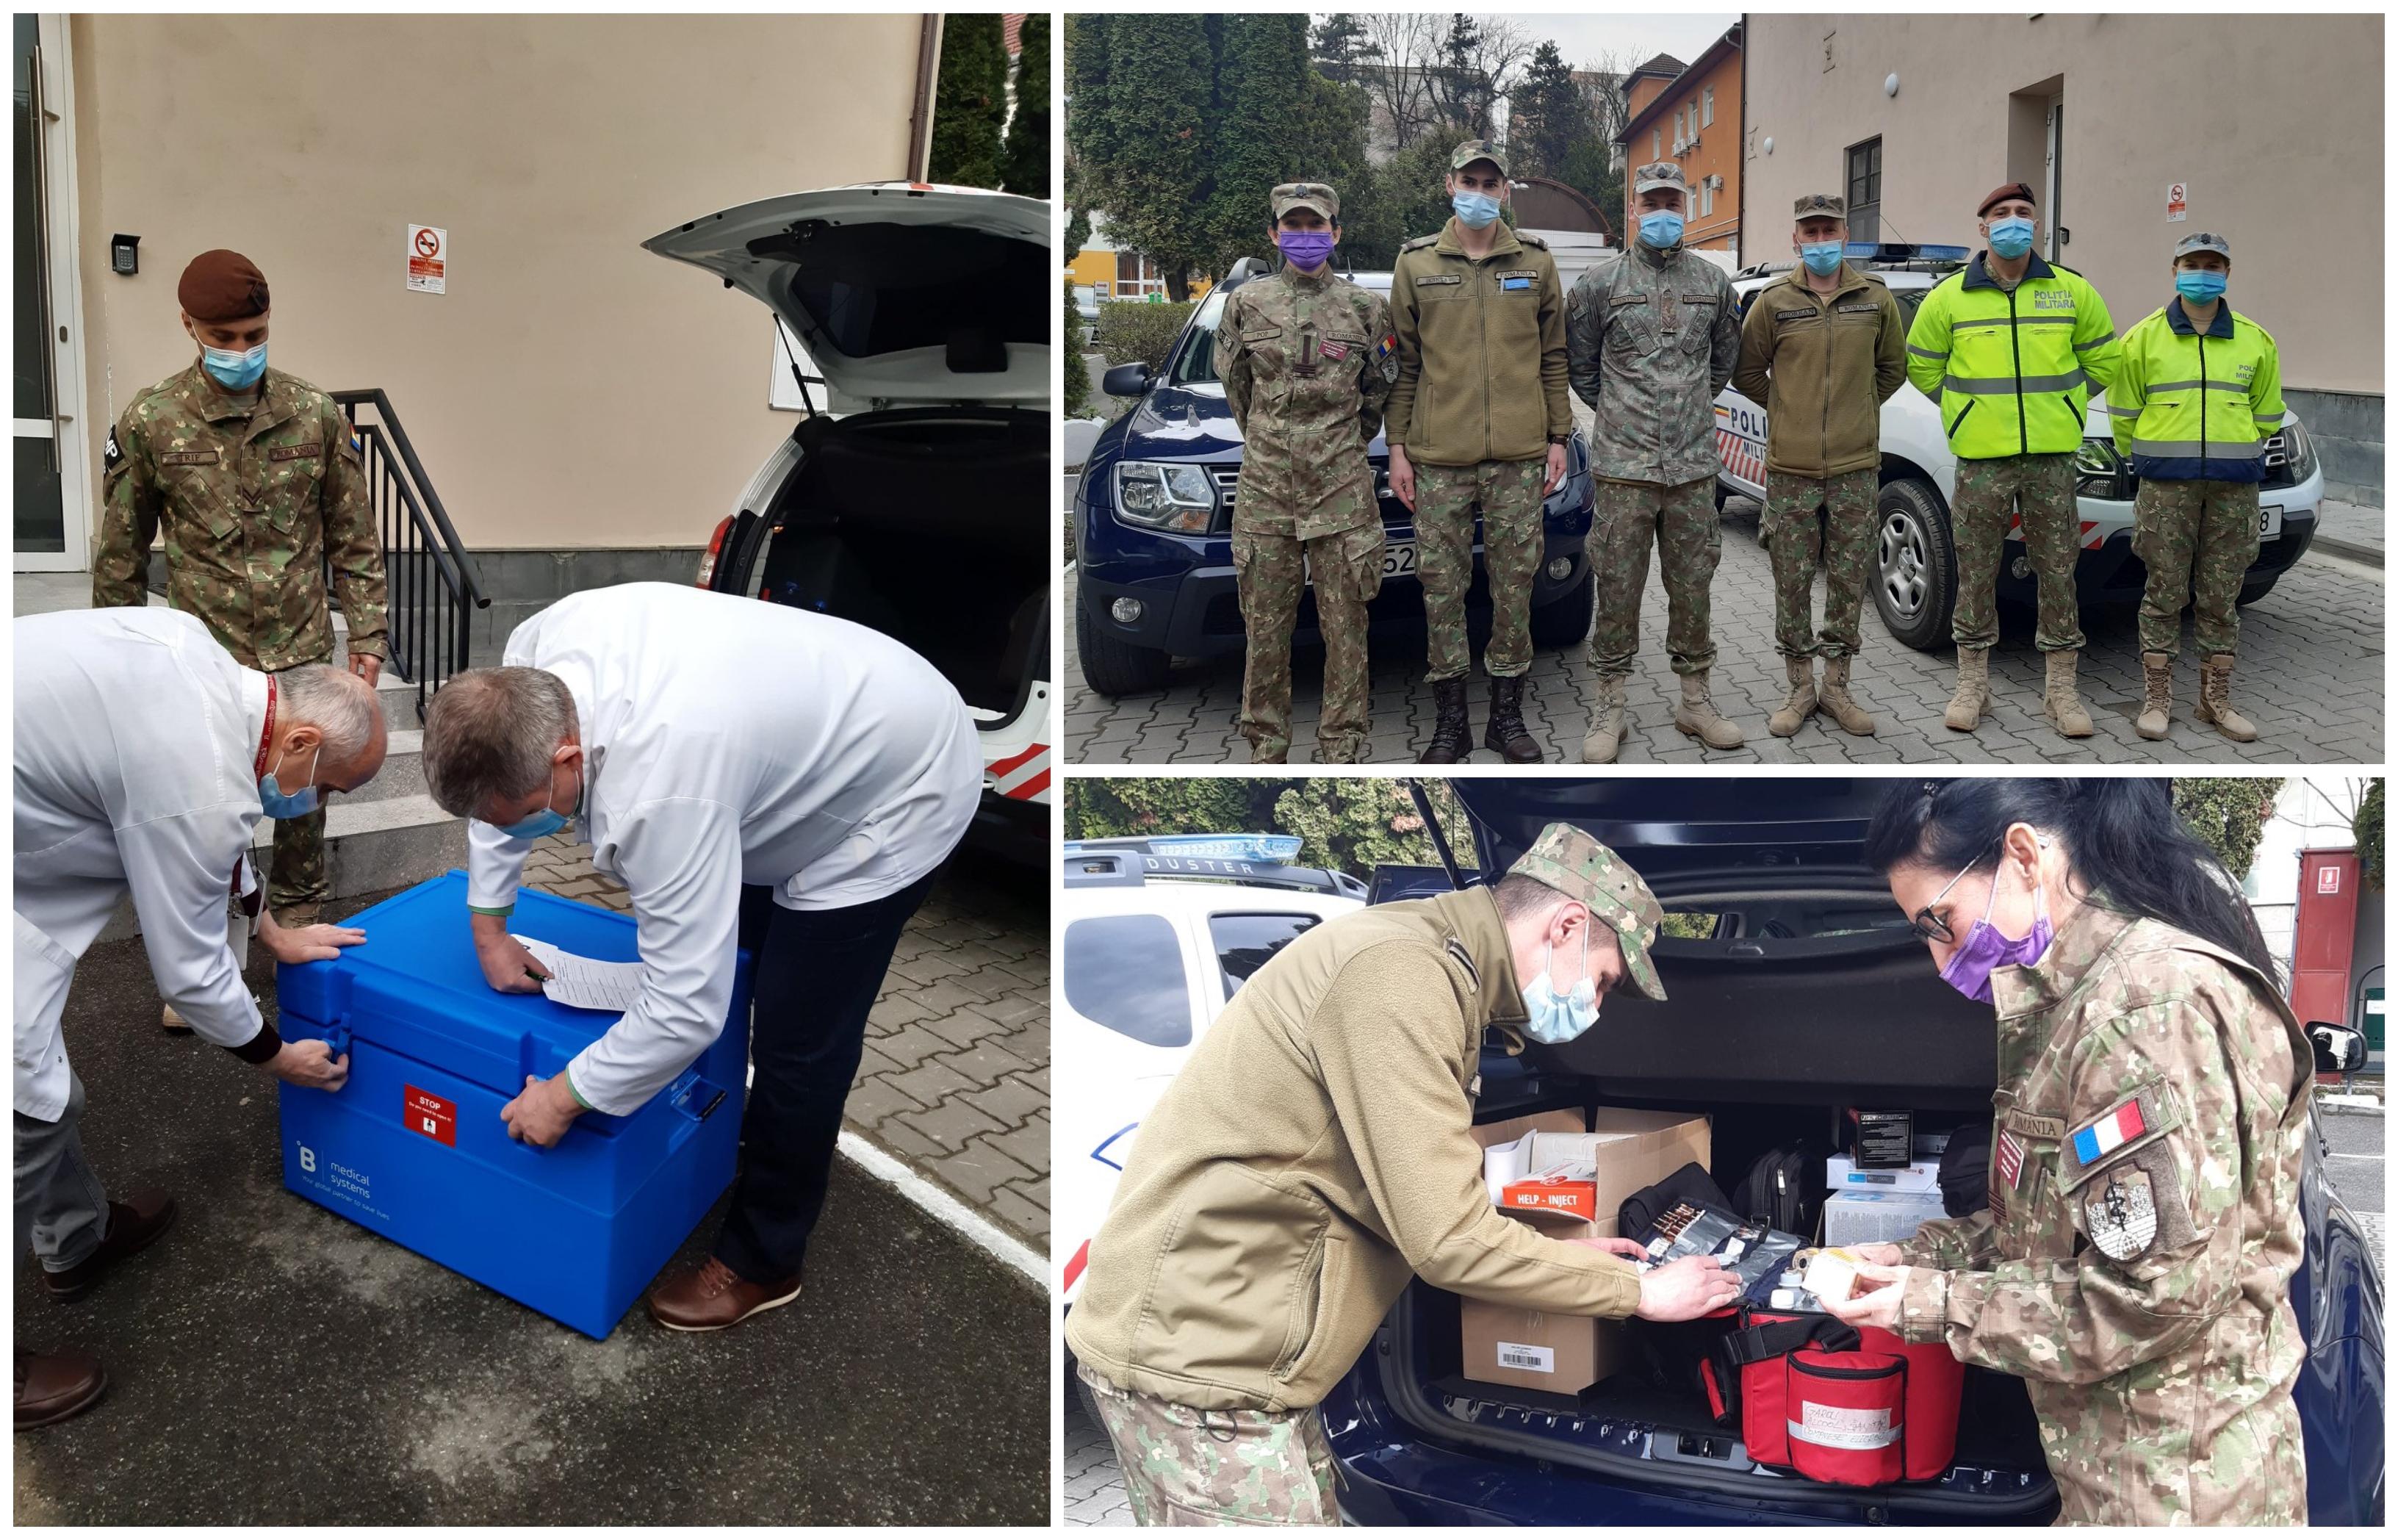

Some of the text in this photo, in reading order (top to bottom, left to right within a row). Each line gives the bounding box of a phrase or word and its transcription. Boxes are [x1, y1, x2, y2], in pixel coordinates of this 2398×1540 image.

[1146, 857, 1254, 874] DUSTER
[420, 1096, 441, 1110] STOP
[331, 1162, 370, 1187] medical
[302, 1175, 314, 1184] Your
[314, 1181, 331, 1192] global
[332, 1190, 353, 1203] partner
[354, 1198, 361, 1207] to
[362, 1203, 375, 1214] save
[331, 1175, 370, 1199] systems
[1517, 1194, 1540, 1205] HELP
[1548, 1195, 1577, 1207] INJECT
